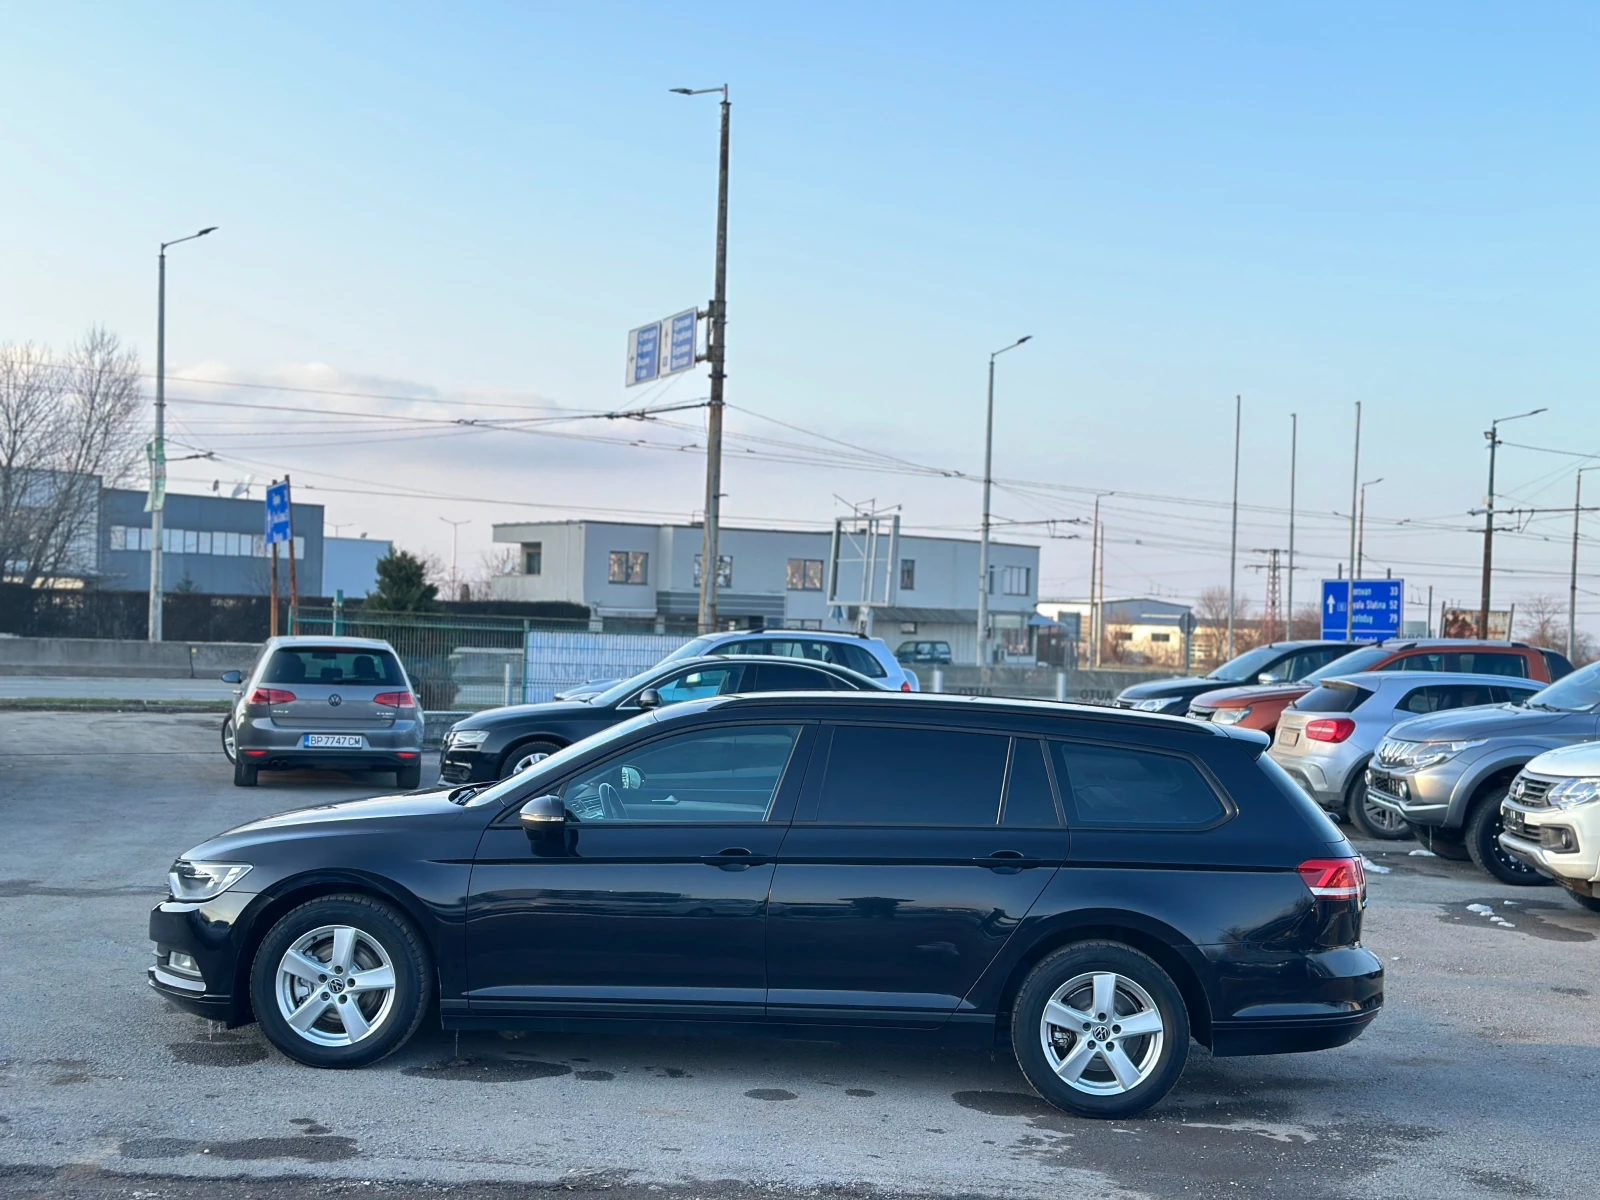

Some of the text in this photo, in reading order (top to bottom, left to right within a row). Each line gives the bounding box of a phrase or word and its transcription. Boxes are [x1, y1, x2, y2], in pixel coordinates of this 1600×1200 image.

[1352, 586, 1398, 596] orovan 33
[1366, 600, 1386, 610] Slatina
[1389, 600, 1398, 610] 52
[1352, 613, 1398, 625] ozloduy 79
[310, 735, 361, 746] BP 7747 CM
